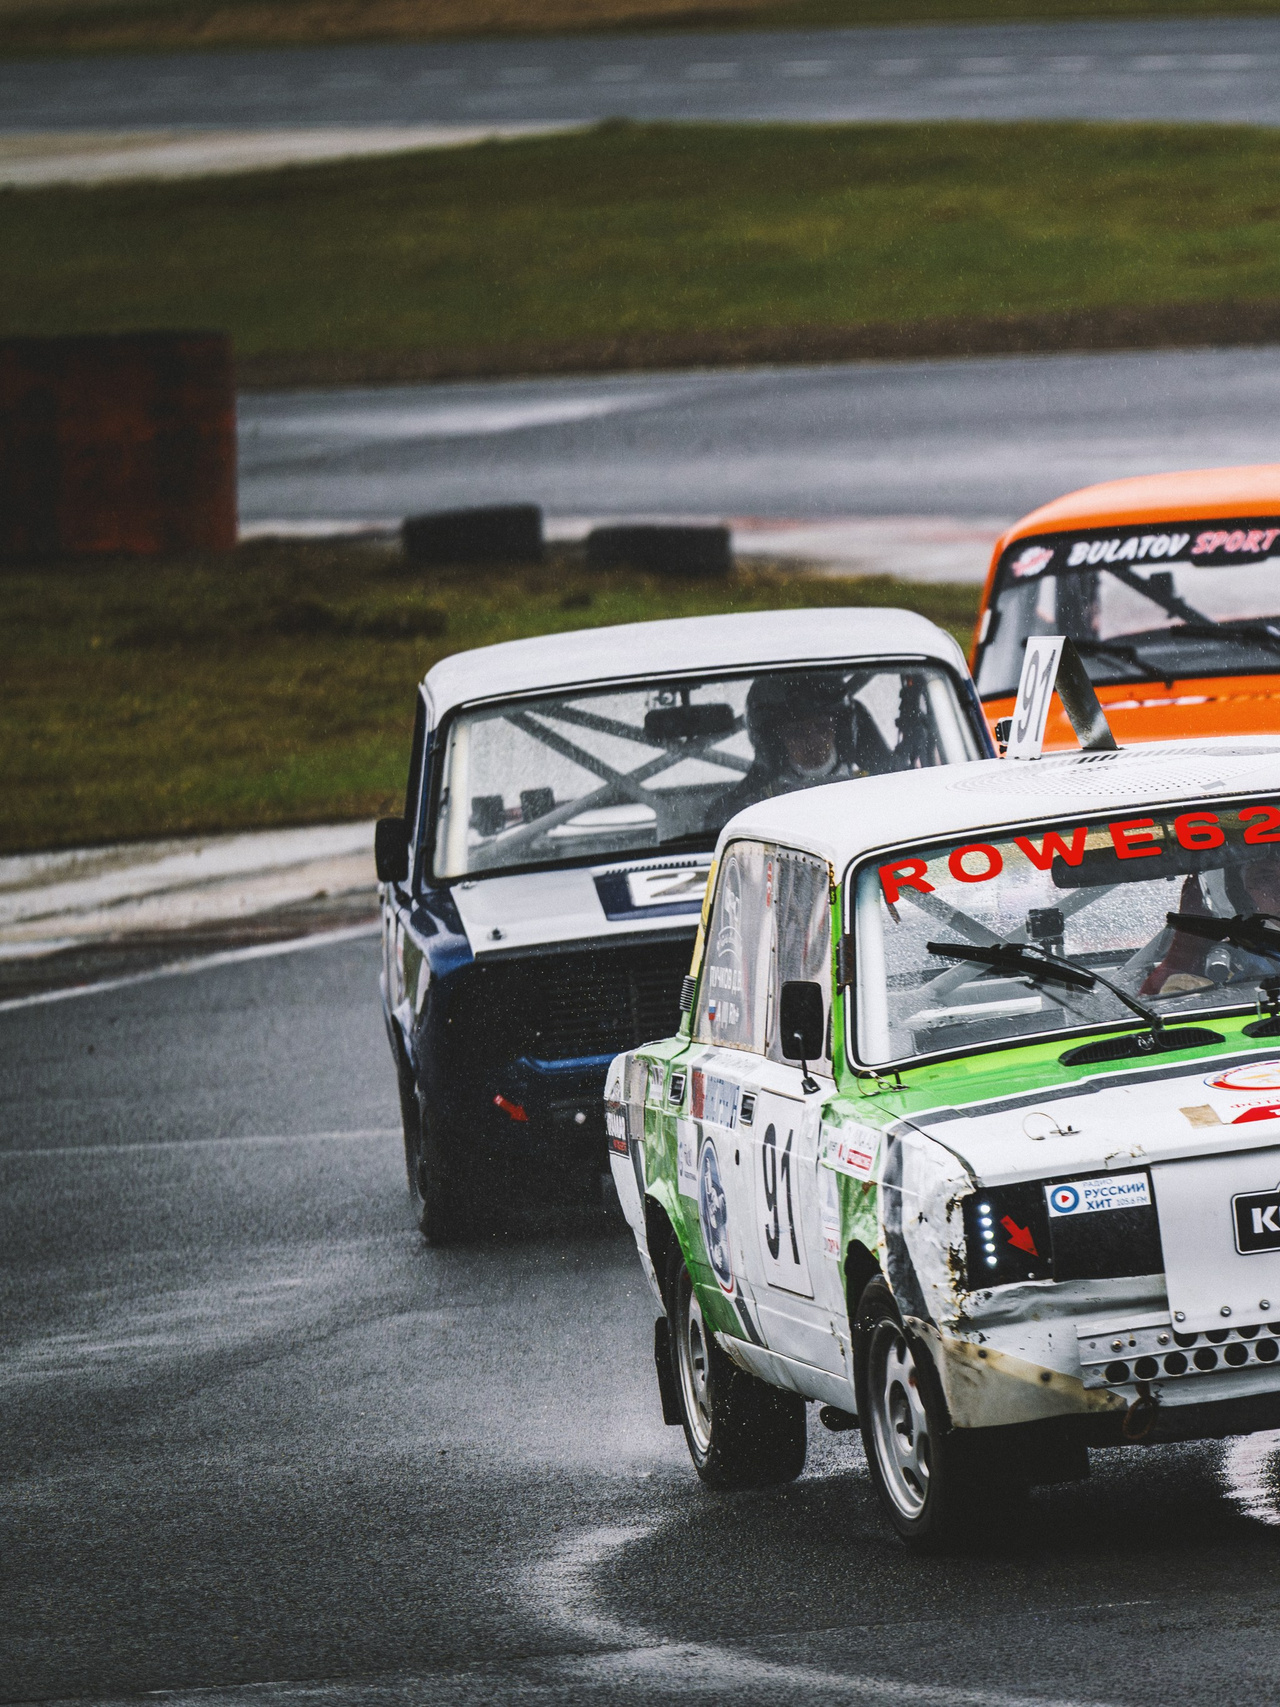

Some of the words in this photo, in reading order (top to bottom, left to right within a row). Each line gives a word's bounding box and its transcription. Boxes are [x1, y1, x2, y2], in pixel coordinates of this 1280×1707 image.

[1066, 532, 1190, 567] BULATOV
[1017, 649, 1056, 744] 91
[762, 1122, 800, 1266] 91
[1084, 1182, 1146, 1198] РУССКИЙ
[1086, 1198, 1112, 1210] ХИТ
